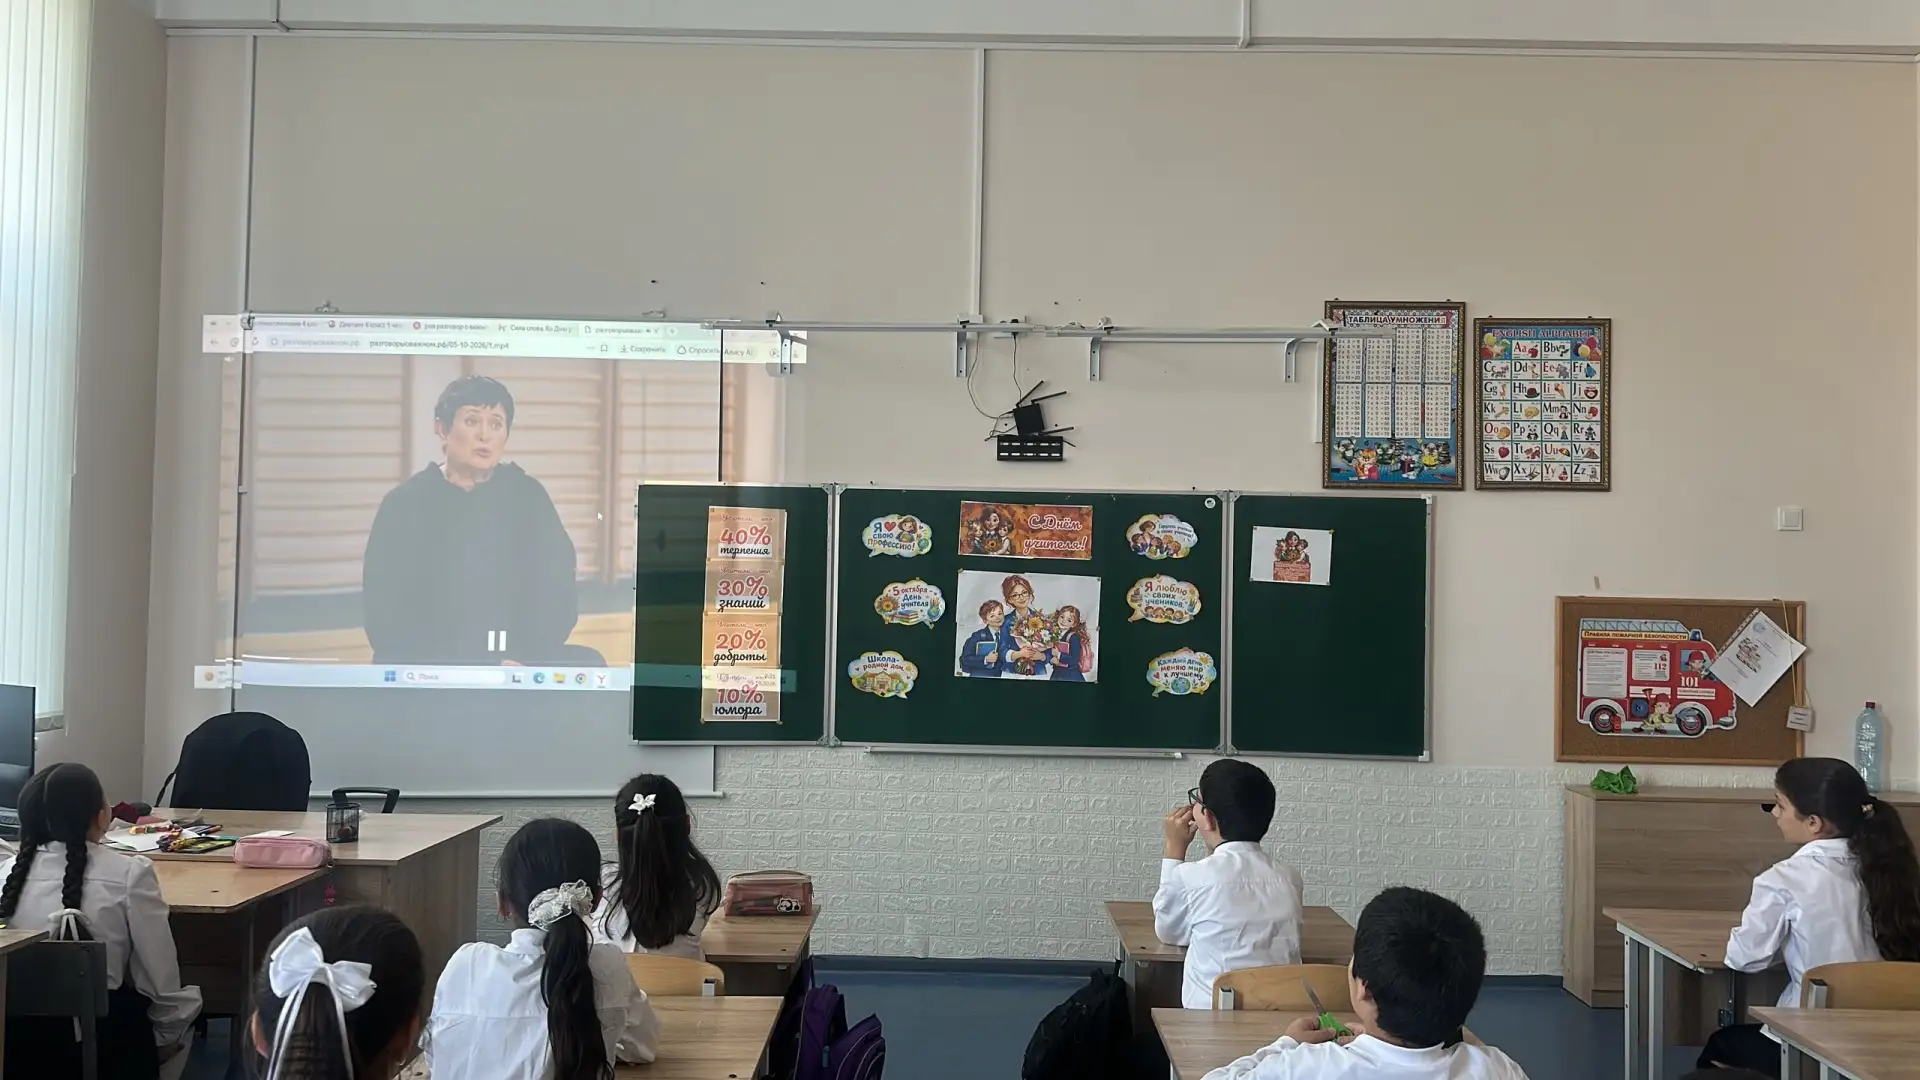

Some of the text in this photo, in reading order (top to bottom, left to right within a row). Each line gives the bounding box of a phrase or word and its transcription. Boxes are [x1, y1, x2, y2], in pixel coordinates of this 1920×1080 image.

[1492, 330, 1591, 338] ENGLISH ALPHABET
[630, 345, 666, 354] Сохранить
[874, 522, 882, 532] Я
[1028, 514, 1082, 530] С Днём
[720, 525, 772, 546] 40%
[1023, 536, 1088, 555] учителя!
[720, 547, 770, 559] терпения
[718, 576, 768, 596] 30%
[893, 585, 928, 596] 5 октября
[1145, 582, 1188, 596] Я люблю
[718, 596, 766, 612] знаний
[903, 594, 922, 602] День
[1146, 599, 1184, 608] учеников.
[901, 601, 928, 610] учителя
[716, 629, 767, 650] 20%
[714, 648, 767, 666] доброты
[863, 662, 888, 671] родной
[1654, 662, 1667, 670] 112
[1681, 676, 1698, 688] 101
[718, 684, 764, 704] 10%
[714, 706, 762, 720] юмора
